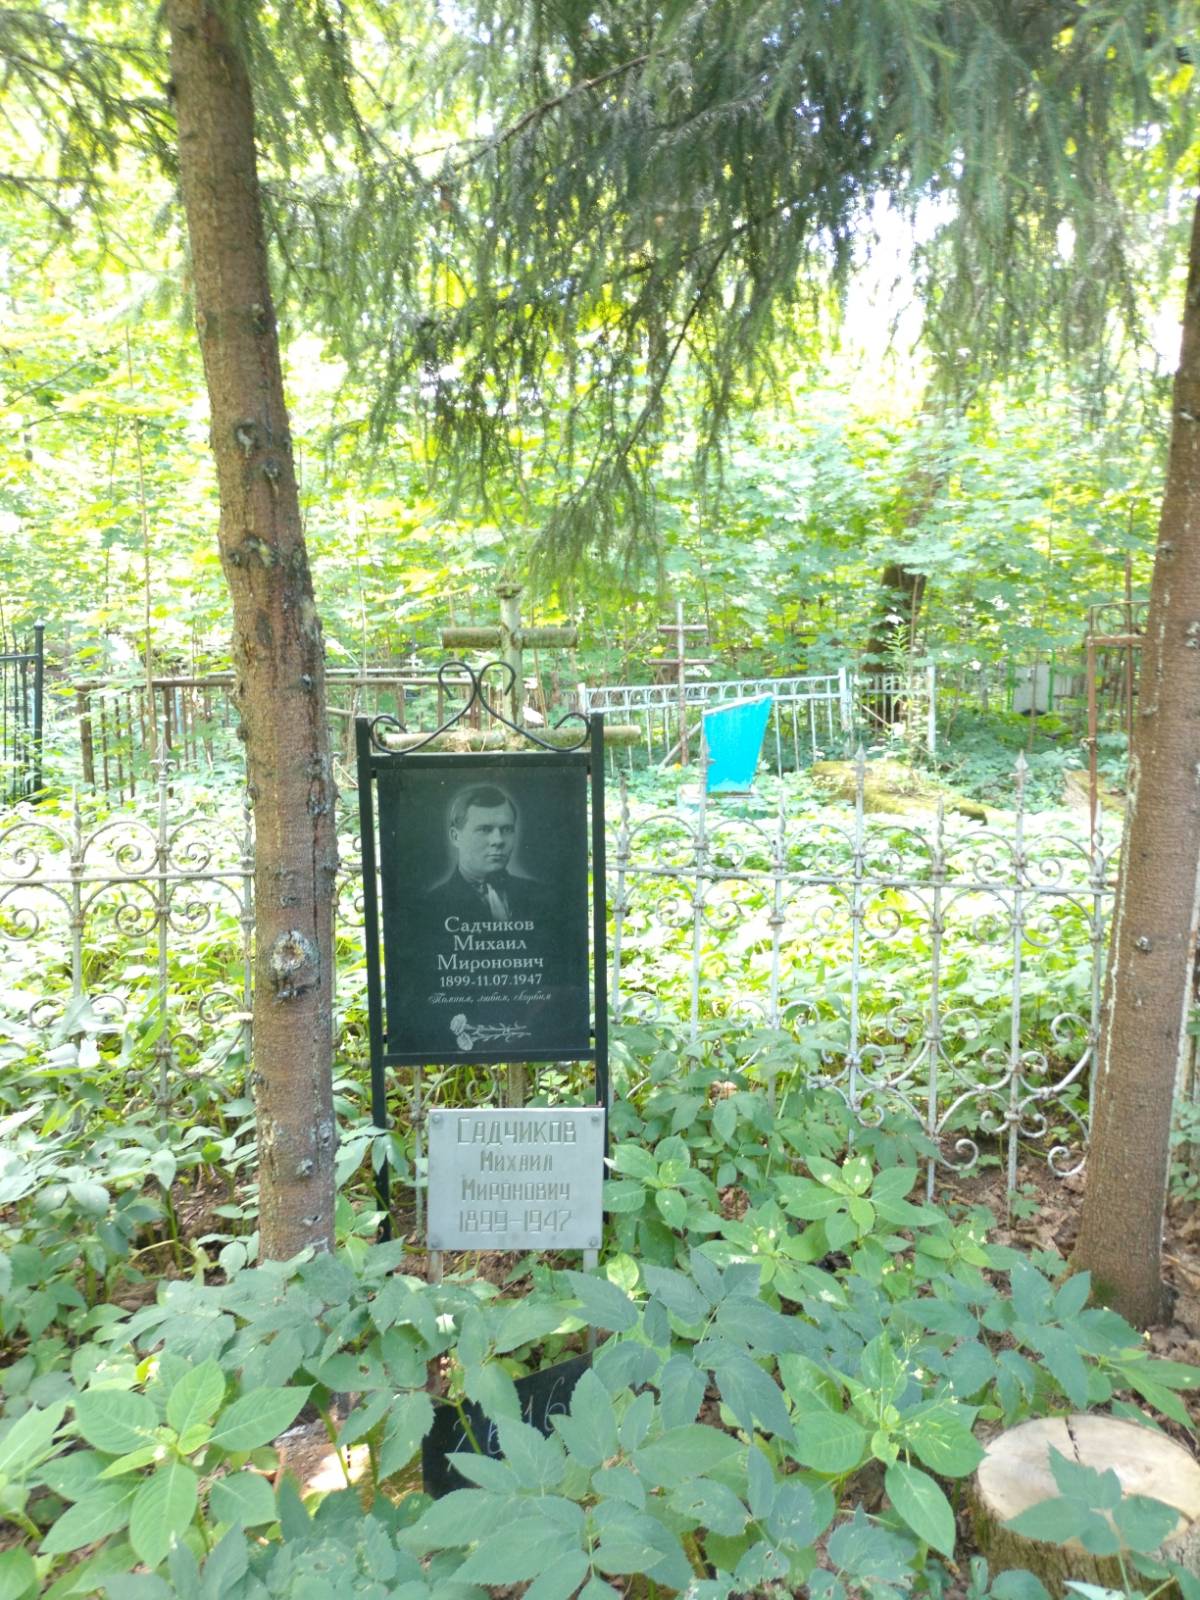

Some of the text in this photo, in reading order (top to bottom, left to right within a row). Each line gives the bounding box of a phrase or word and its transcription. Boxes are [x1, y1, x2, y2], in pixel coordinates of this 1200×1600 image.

[444, 916, 535, 934] Садчиков
[453, 935, 527, 951] Михаил
[437, 953, 544, 972] Миронович
[440, 973, 542, 987] 1899-11.07.1947
